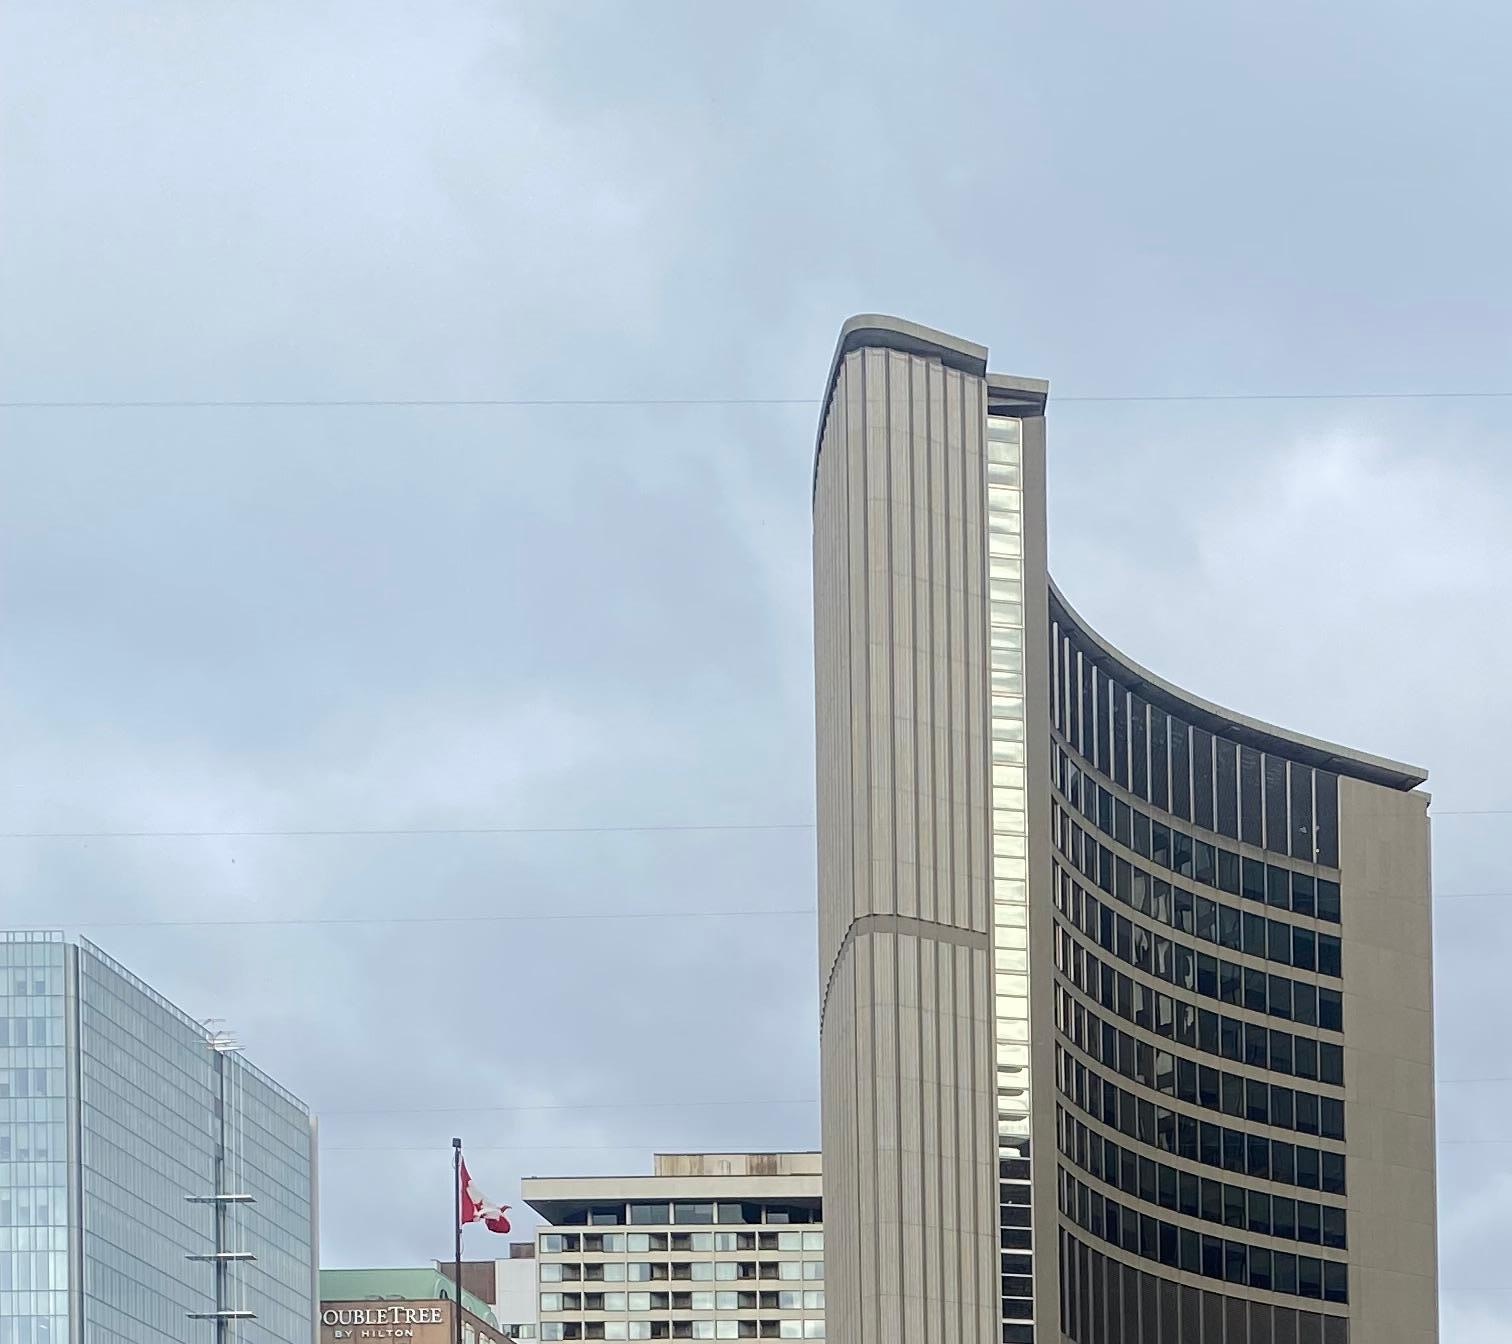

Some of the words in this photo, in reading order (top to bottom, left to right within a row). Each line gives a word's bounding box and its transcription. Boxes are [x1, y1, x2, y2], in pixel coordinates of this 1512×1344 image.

[320, 1306, 443, 1326] OUBLETREE
[334, 1330, 353, 1338] BY
[361, 1329, 414, 1338] HILTON
